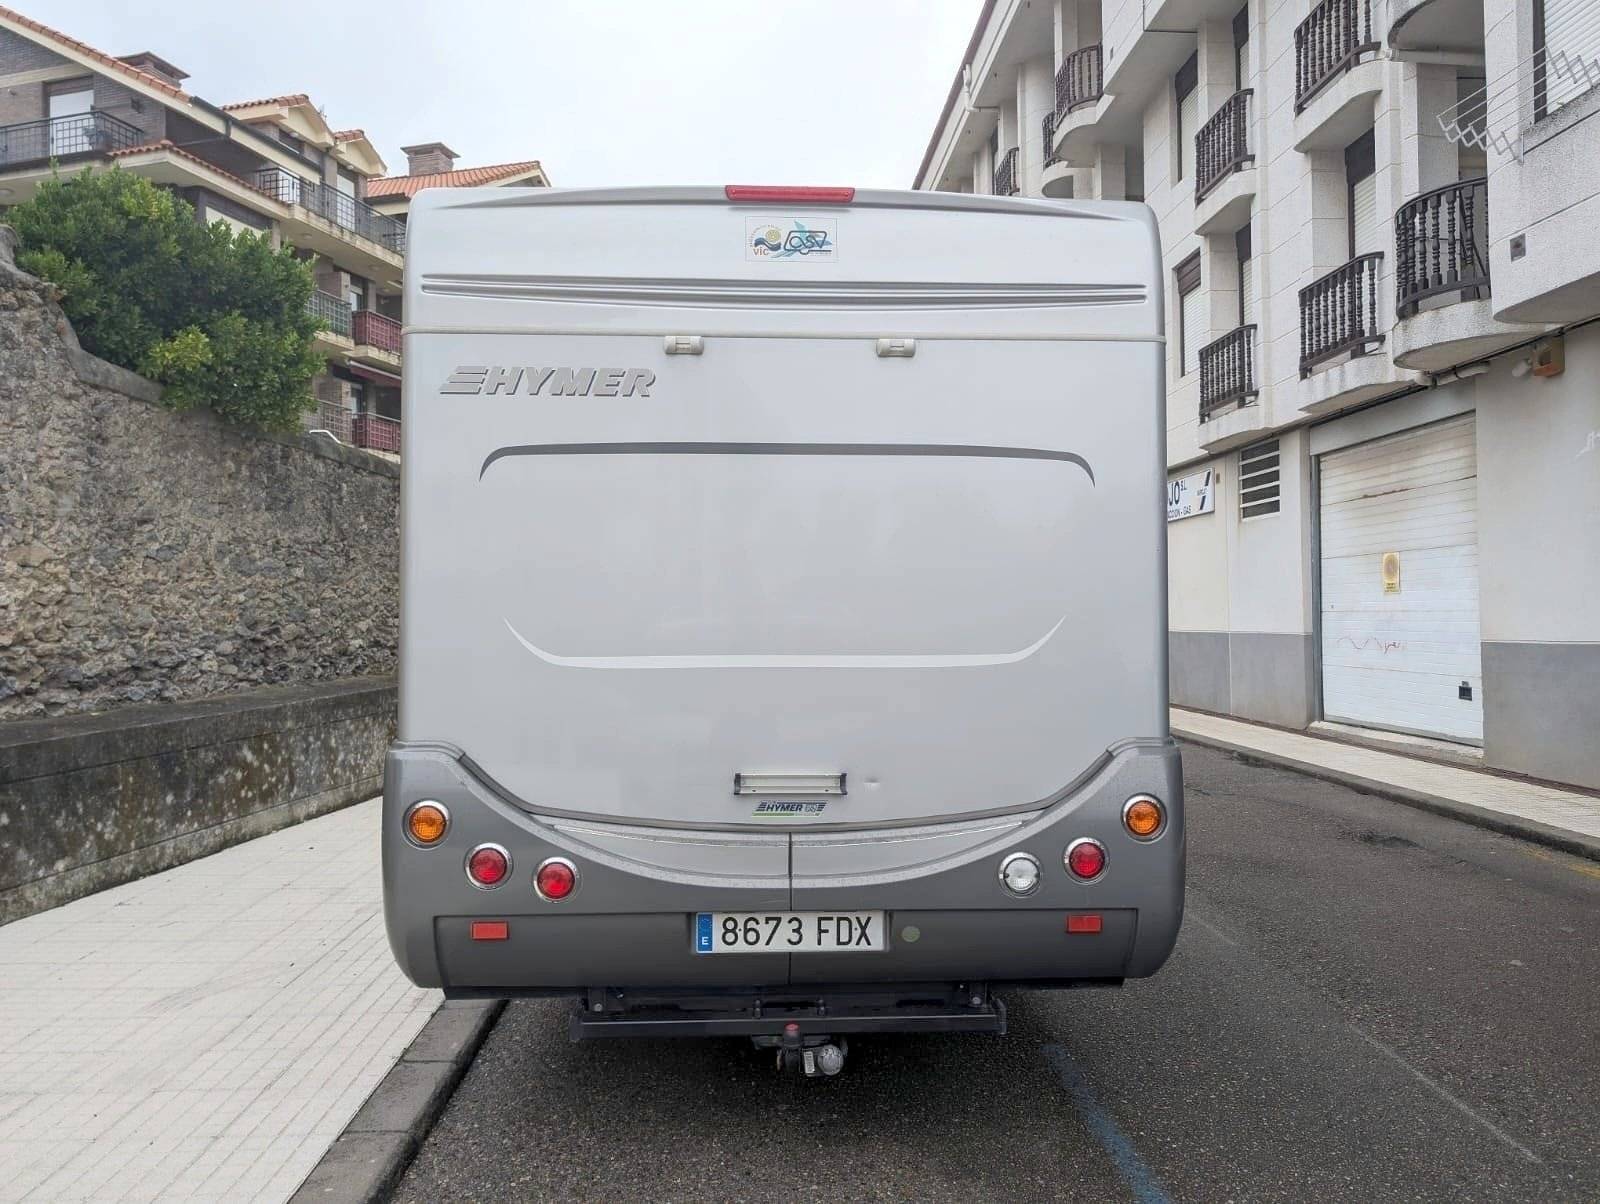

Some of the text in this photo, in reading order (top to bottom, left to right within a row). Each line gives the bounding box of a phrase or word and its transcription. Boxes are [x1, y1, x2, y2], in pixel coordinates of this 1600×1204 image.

[484, 366, 656, 397] HYMER
[766, 802, 803, 812] HYMER
[701, 936, 709, 945] E
[721, 916, 872, 946] 8673 FDX
